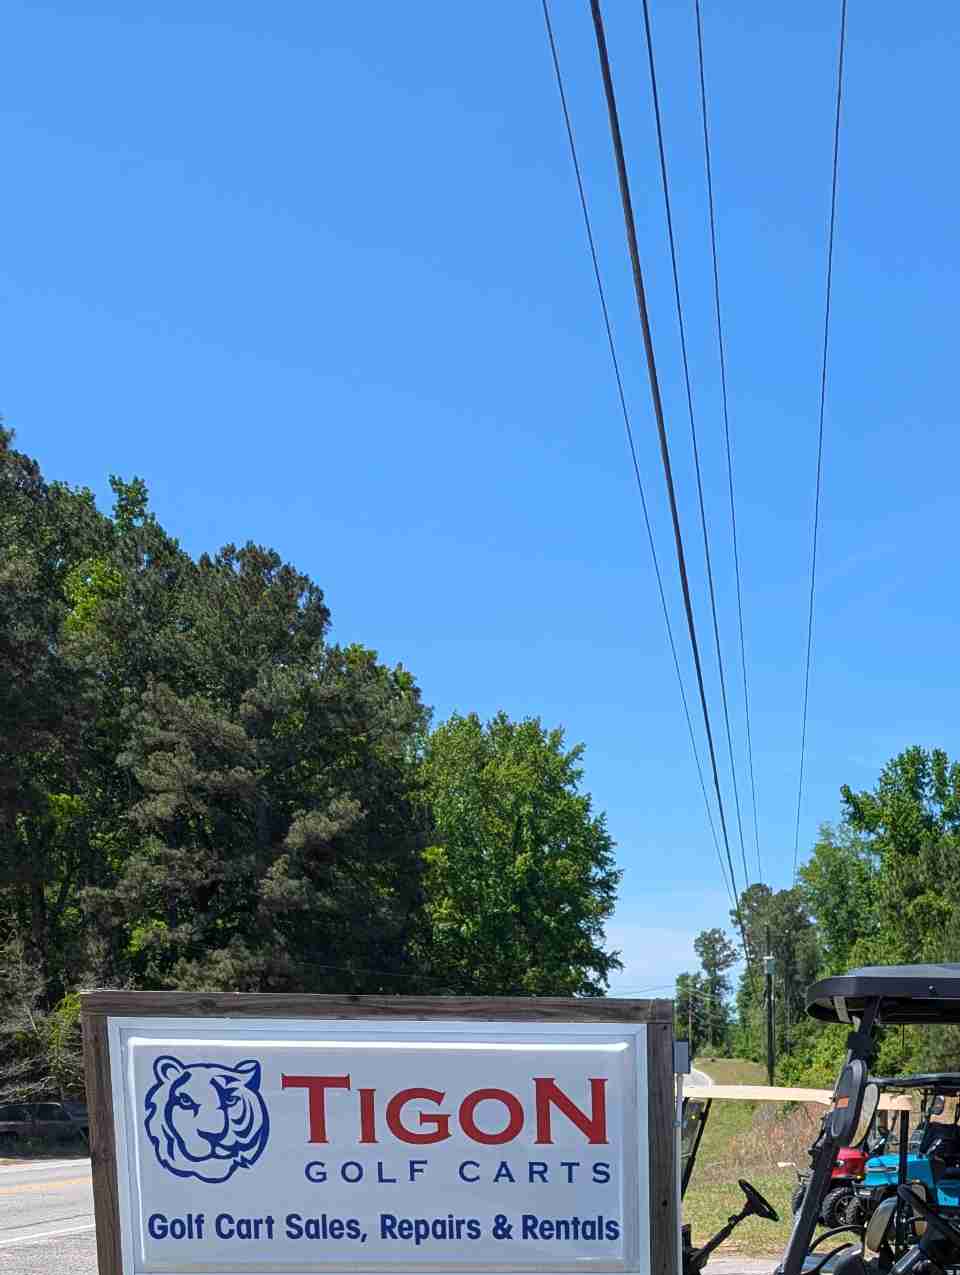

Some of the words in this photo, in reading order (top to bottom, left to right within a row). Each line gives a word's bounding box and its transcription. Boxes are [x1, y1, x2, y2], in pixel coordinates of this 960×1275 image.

[281, 1073, 609, 1146] TIGON
[304, 1159, 429, 1184] GOLF
[458, 1160, 611, 1184] CARTS
[147, 1213, 205, 1240] Golf
[215, 1213, 275, 1240] Cart
[285, 1213, 368, 1243] Sales,
[380, 1213, 482, 1246] Repairs
[492, 1213, 513, 1240] &
[521, 1214, 620, 1241] Rentals
